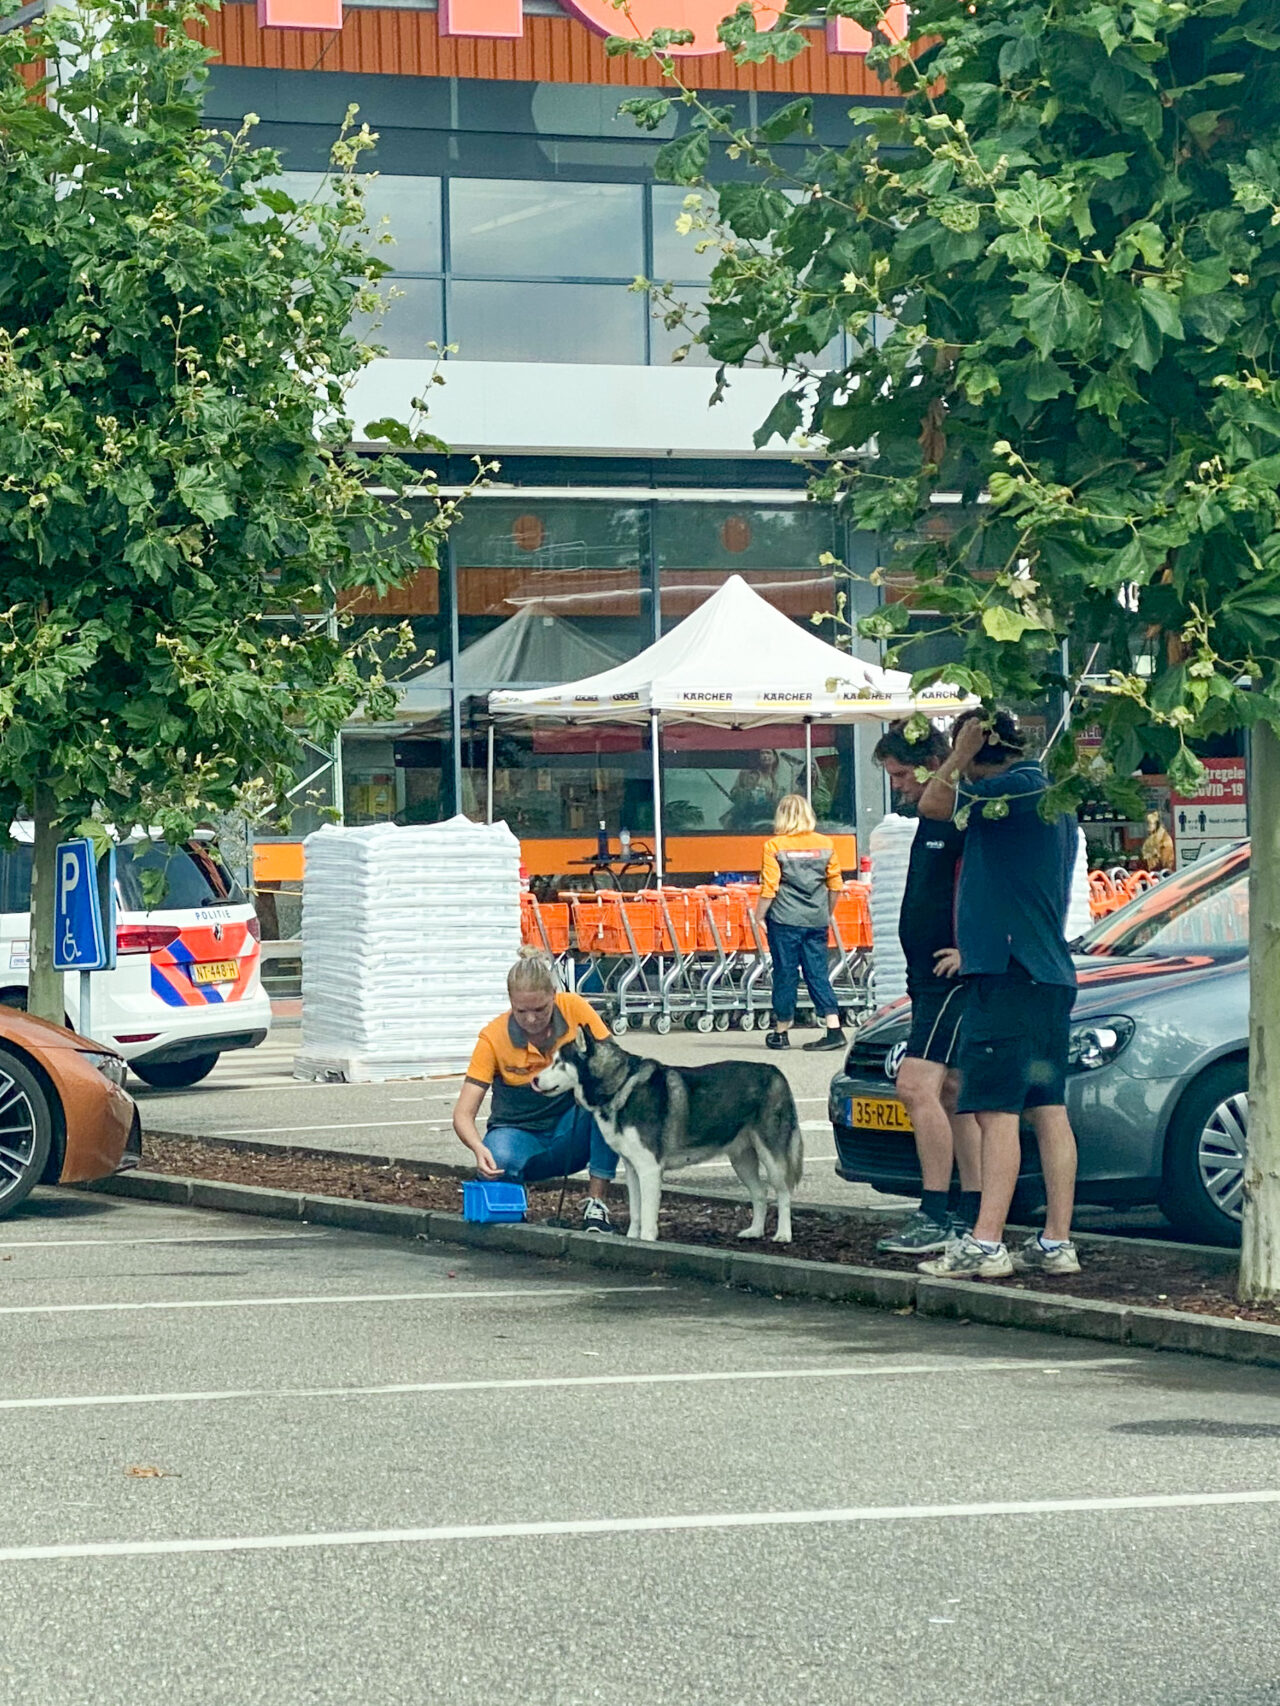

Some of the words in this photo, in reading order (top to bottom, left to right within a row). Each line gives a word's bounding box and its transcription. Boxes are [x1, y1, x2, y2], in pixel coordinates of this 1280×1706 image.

[683, 692, 733, 701] KÄRCHER
[763, 692, 813, 701] KÄRCHER
[843, 692, 892, 701] KÄHER
[1195, 783, 1243, 796] OVID-19
[62, 852, 80, 915] P
[195, 909, 232, 920] POLITIE
[196, 963, 236, 981] NT-448-H
[856, 1101, 913, 1127] 35-RZL-
